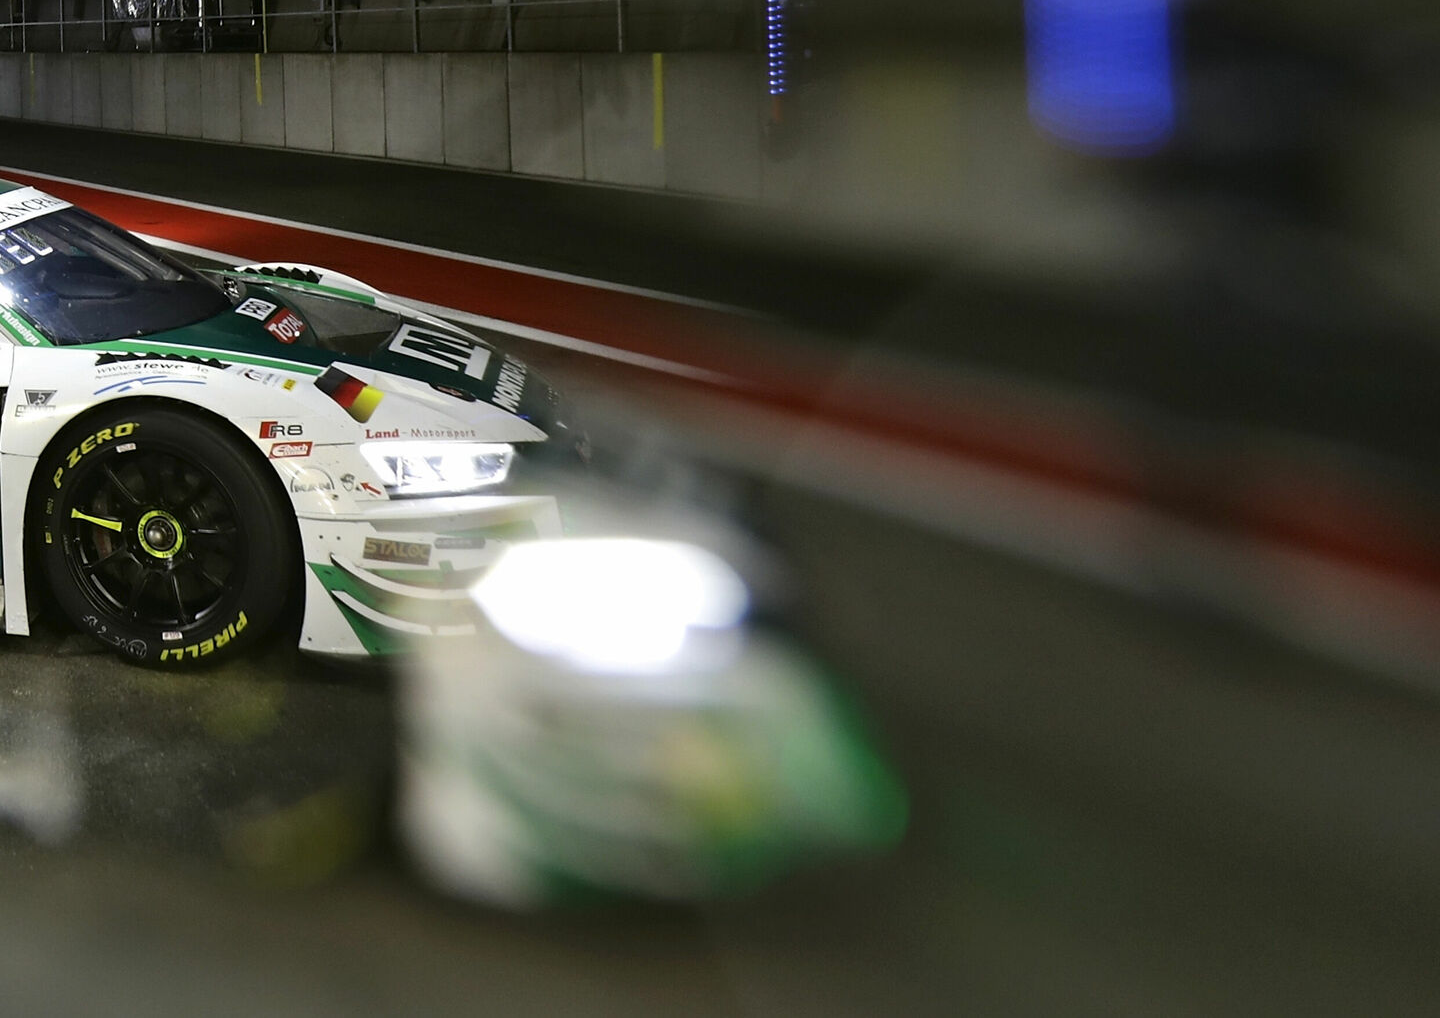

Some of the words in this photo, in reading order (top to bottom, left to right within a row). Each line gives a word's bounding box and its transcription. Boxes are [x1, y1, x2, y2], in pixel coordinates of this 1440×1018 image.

[268, 313, 303, 342] TOTAL
[269, 424, 303, 437] R8
[365, 428, 400, 440] Land
[410, 428, 477, 439] Motorsport
[66, 422, 135, 469] ZERO
[364, 538, 429, 560] STALOC
[160, 610, 248, 661] PIRELLI
